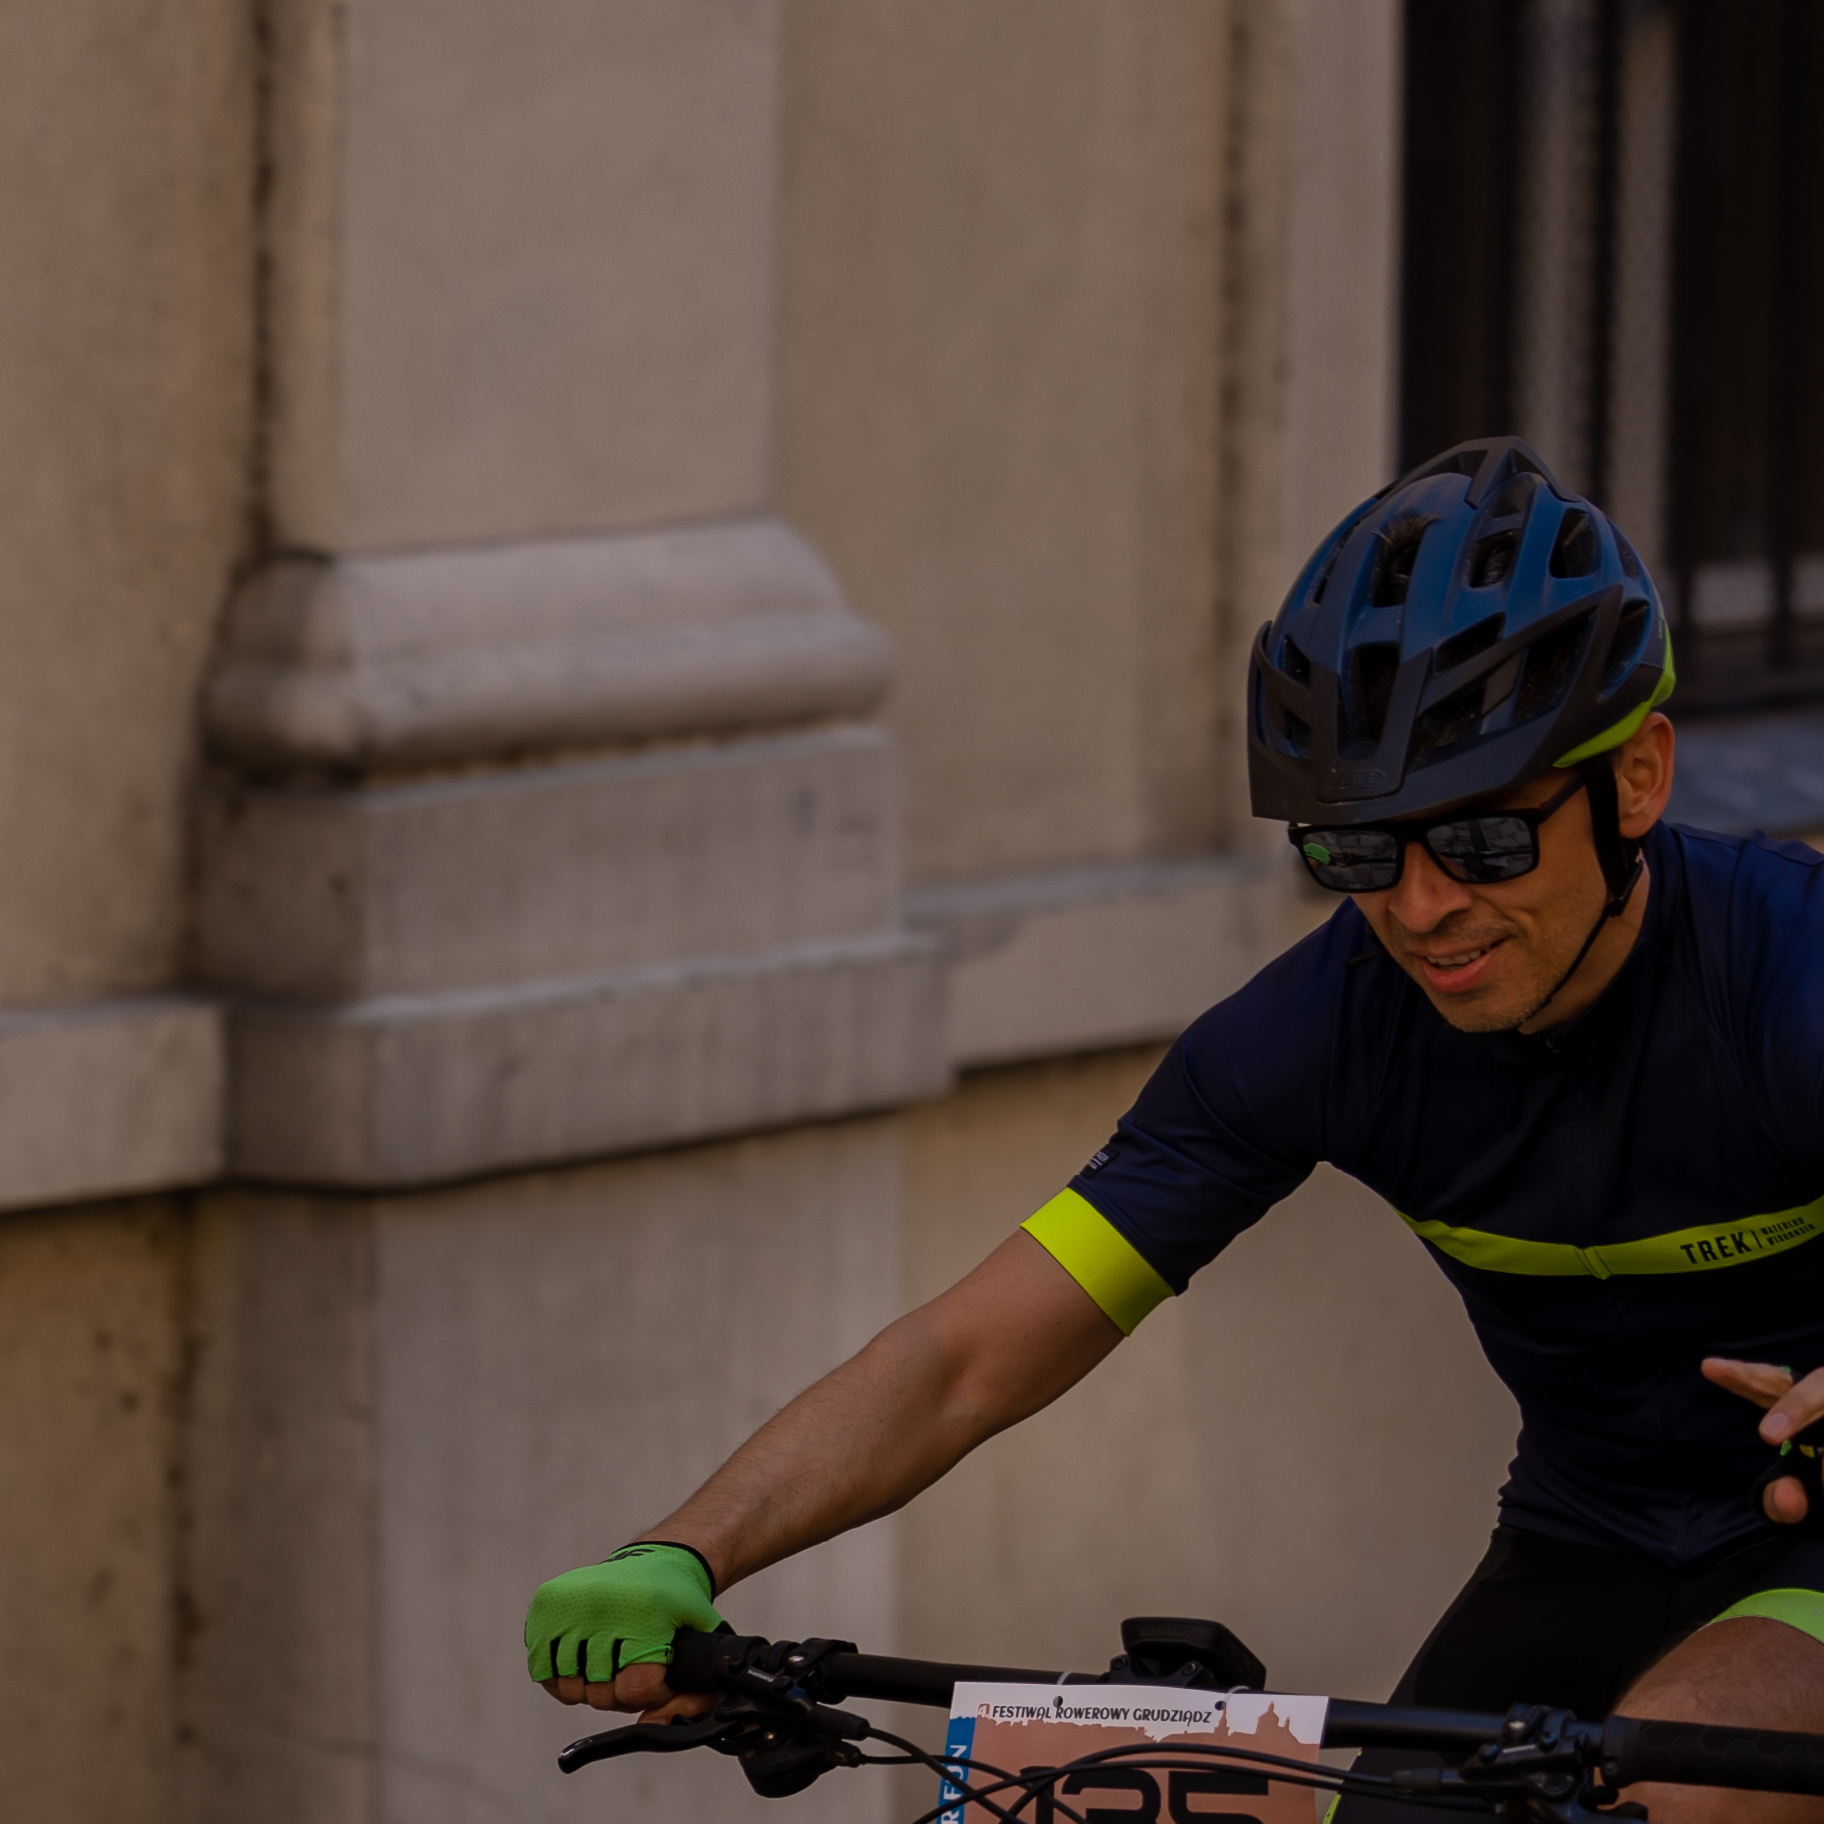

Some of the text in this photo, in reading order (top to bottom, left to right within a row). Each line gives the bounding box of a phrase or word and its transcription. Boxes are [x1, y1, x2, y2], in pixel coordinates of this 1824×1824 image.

[1760, 1217, 1805, 1236] WATERLOO
[1766, 1223, 1816, 1246] WISCONSIN
[1680, 1231, 1752, 1264] TREK
[992, 1705, 1052, 1720] FESTIWAL
[1055, 1706, 1130, 1721] ROWEROWY
[1132, 1707, 1213, 1727] GRUDZIĄDZ
